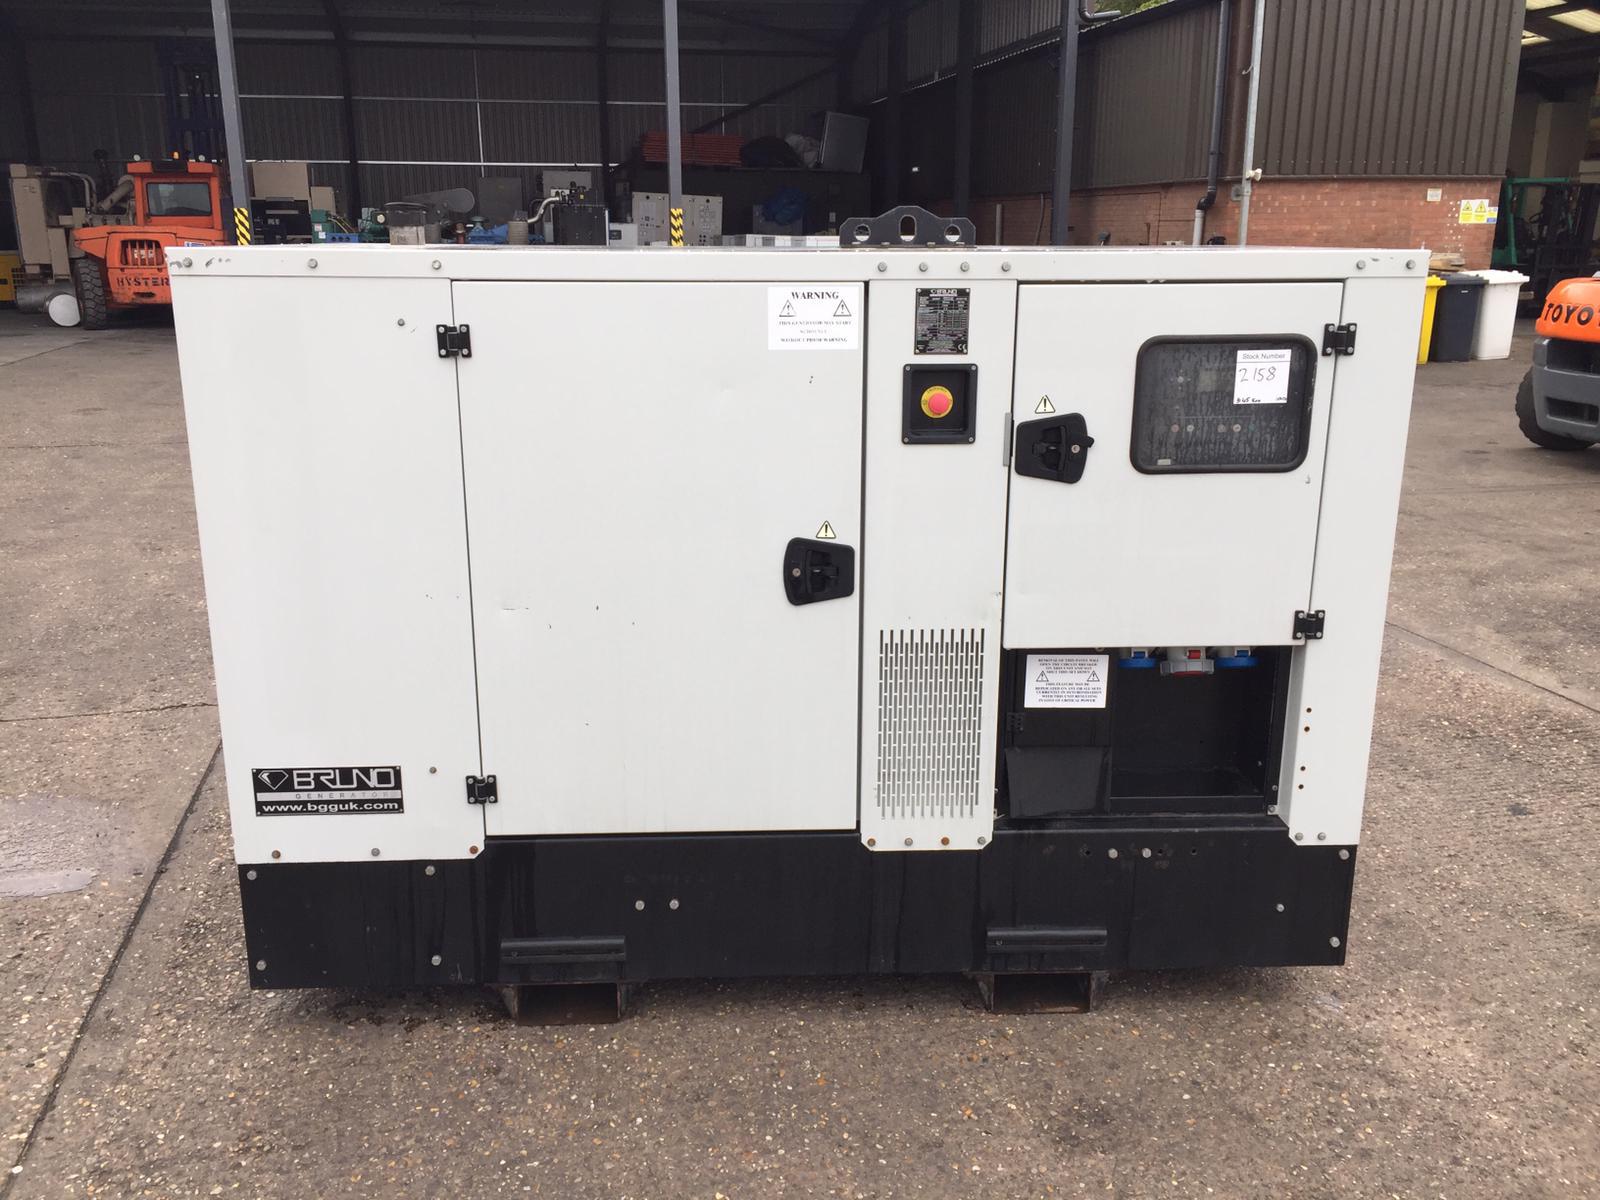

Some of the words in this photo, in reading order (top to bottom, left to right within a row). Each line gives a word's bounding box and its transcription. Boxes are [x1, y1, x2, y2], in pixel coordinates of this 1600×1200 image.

[117, 277, 170, 287] HYSTER
[791, 291, 839, 300] WARNING
[1544, 303, 1600, 326] TOYO
[1238, 366, 1276, 382] 2158
[293, 768, 395, 789] BRUNO
[296, 792, 399, 800] GENERATOR
[262, 802, 399, 813] www.bgguk.com
